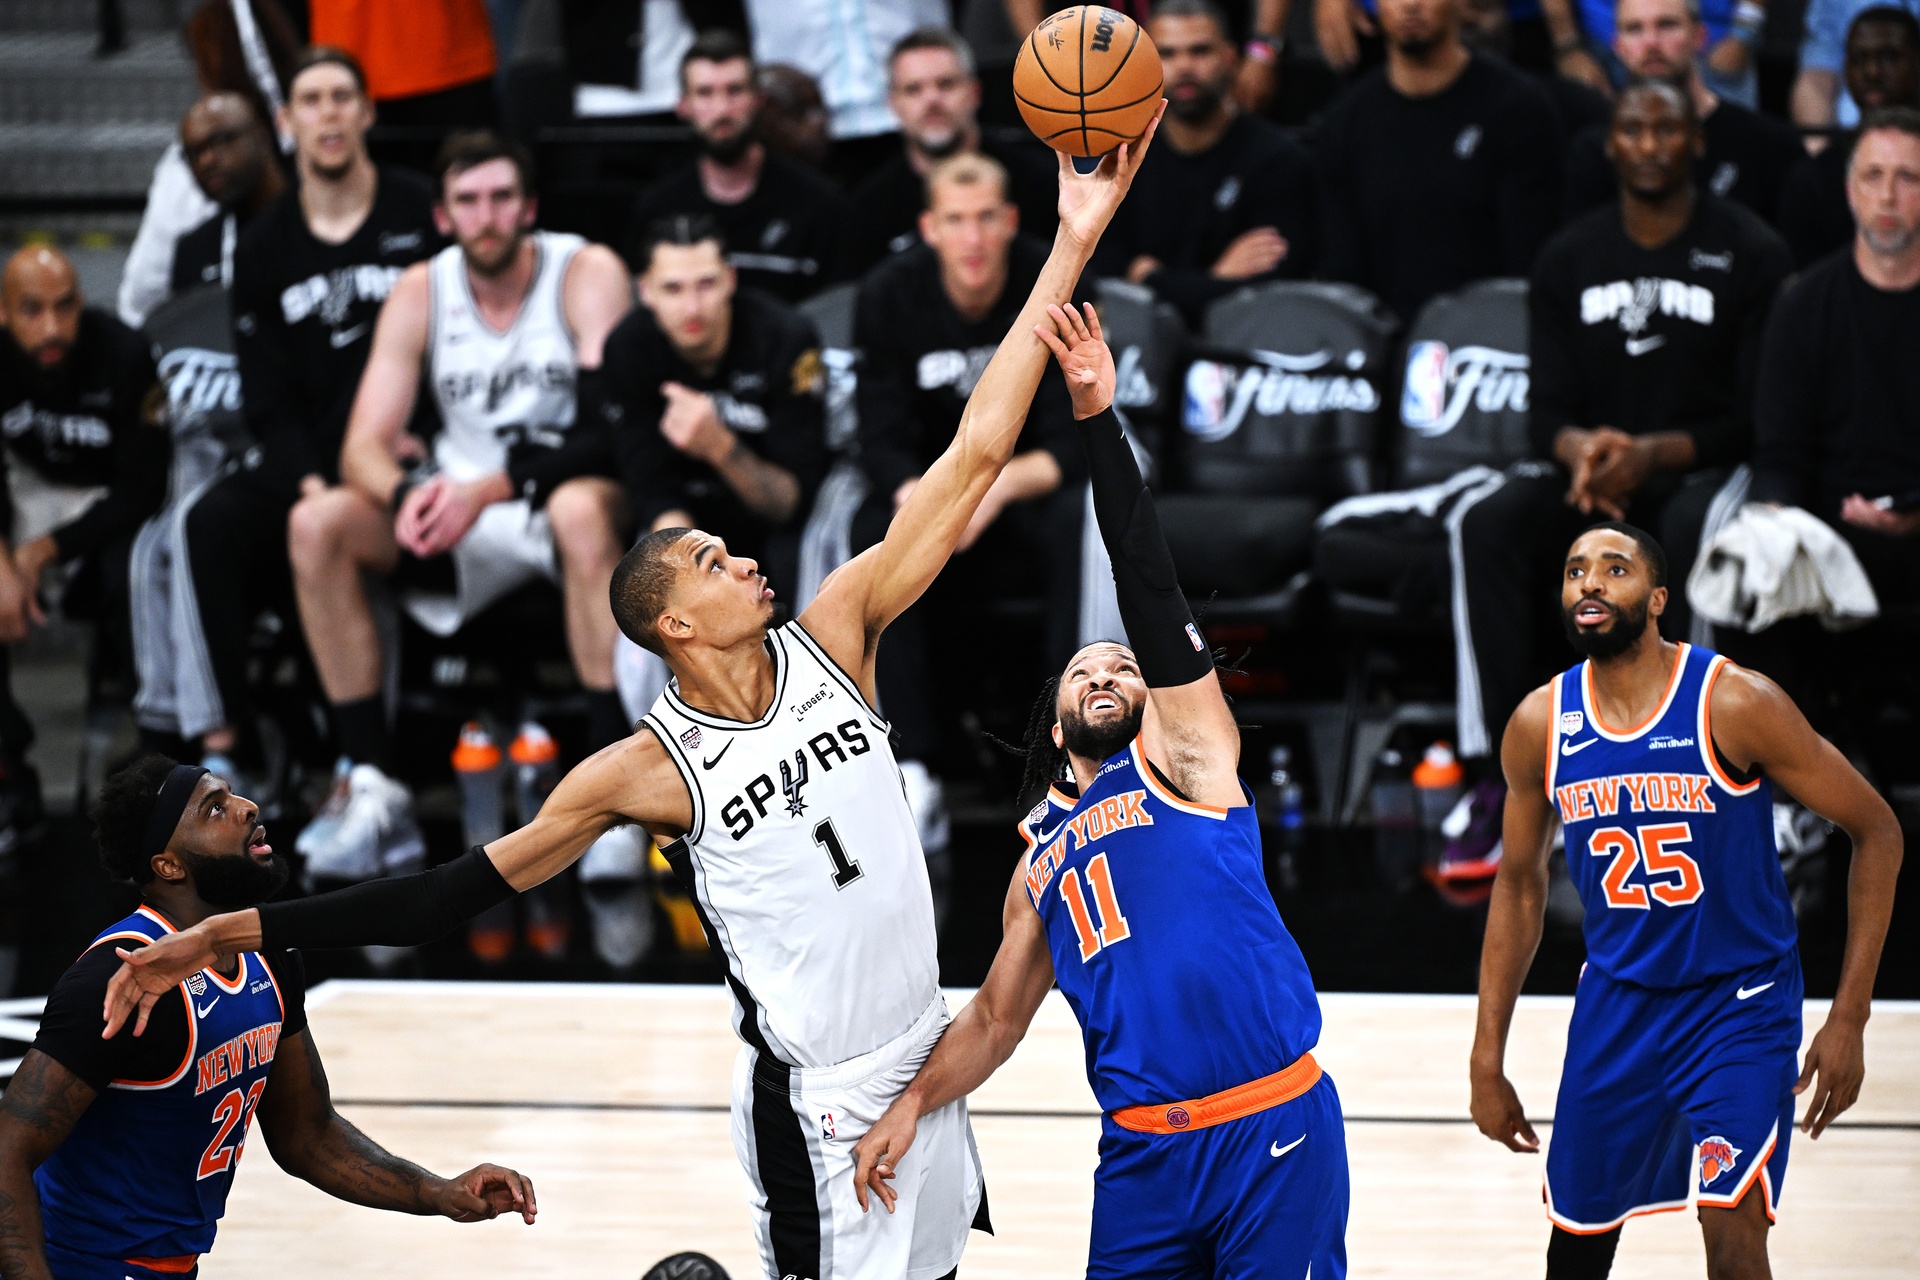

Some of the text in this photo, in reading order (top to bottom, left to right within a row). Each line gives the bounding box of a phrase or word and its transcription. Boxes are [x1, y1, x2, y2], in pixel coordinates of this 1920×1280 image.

[797, 690, 827, 715] LEDGER
[1104, 757, 1130, 774] dhabi
[1649, 739, 1667, 749] abu
[1667, 736, 1694, 748] dhabi
[721, 718, 870, 841] SPURS
[1555, 773, 1717, 825] NEW YORK
[811, 816, 865, 892] 1
[1025, 789, 1155, 911] NEW YORK
[1588, 821, 1705, 910] 25
[1059, 852, 1131, 964] 11
[188, 974, 203, 983] USA
[194, 1034, 244, 1097] NEW
